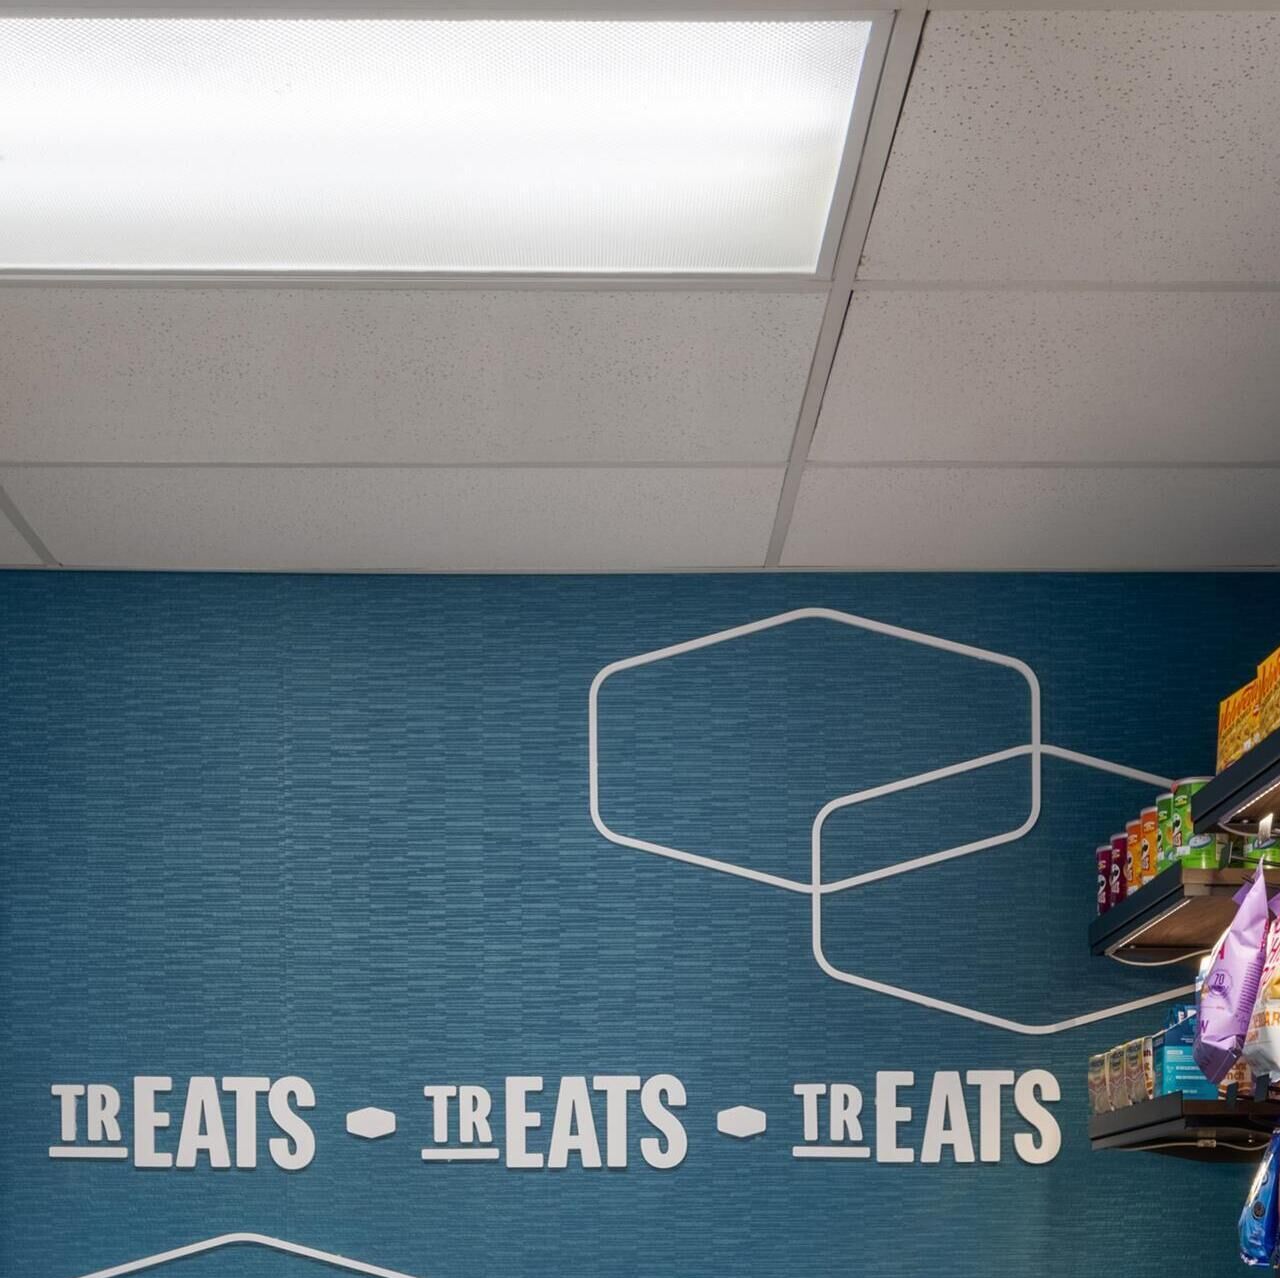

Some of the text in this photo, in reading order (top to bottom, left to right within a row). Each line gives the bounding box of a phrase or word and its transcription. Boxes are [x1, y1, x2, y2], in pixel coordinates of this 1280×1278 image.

[51, 1069, 1061, 1170] TREATS TREATS TREATS
